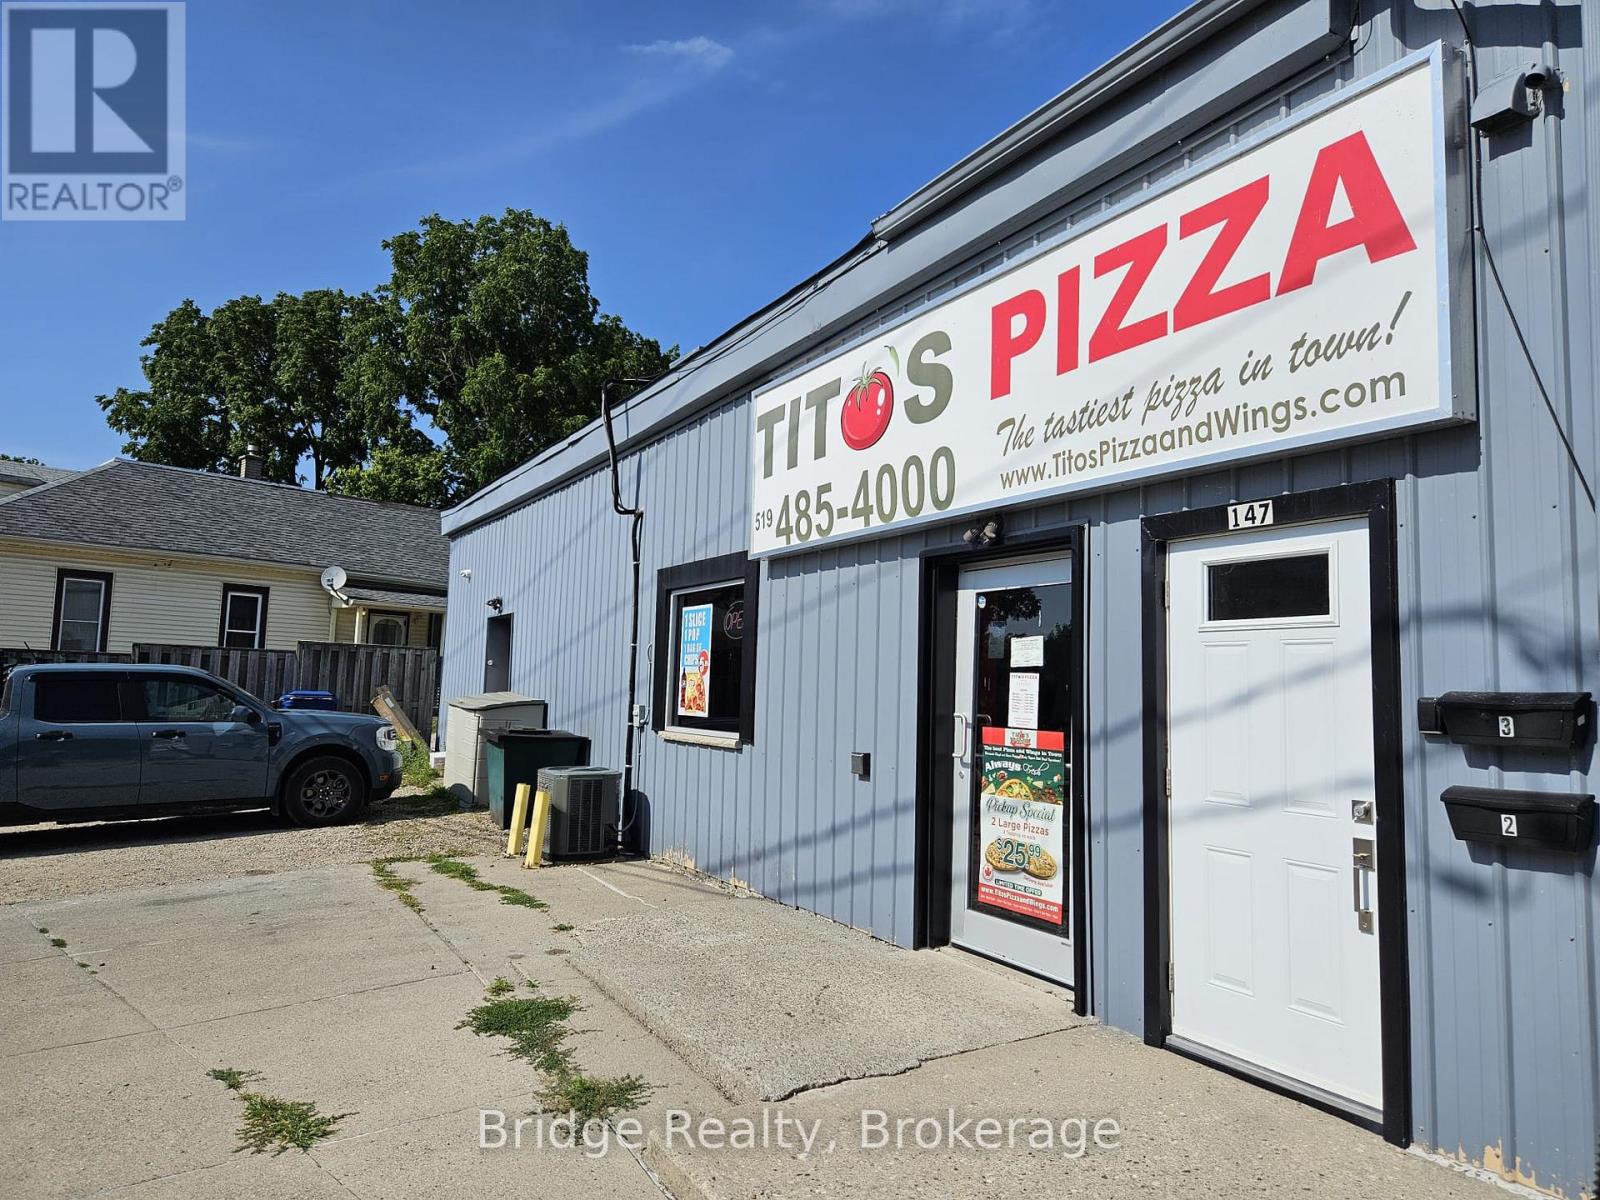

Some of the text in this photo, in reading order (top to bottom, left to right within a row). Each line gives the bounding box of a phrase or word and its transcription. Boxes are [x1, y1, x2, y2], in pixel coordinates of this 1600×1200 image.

[990, 130, 1418, 400] PIZZA
[996, 290, 1413, 457] The tastiest pizza in town!
[999, 371, 1407, 490] www.TitosPizzaandWings.com
[754, 446, 956, 546] 519 485-4000
[1231, 502, 1271, 528] 147
[688, 611, 706, 627] SLICE
[726, 610, 744, 630] OPE
[1500, 717, 1512, 736] 3
[985, 760, 1022, 772] Always
[986, 797, 1056, 823] Pickup Special
[991, 816, 996, 826] 2
[998, 818, 1021, 832] Large
[1023, 822, 1049, 836] Pizzas
[1503, 816, 1515, 835] 2
